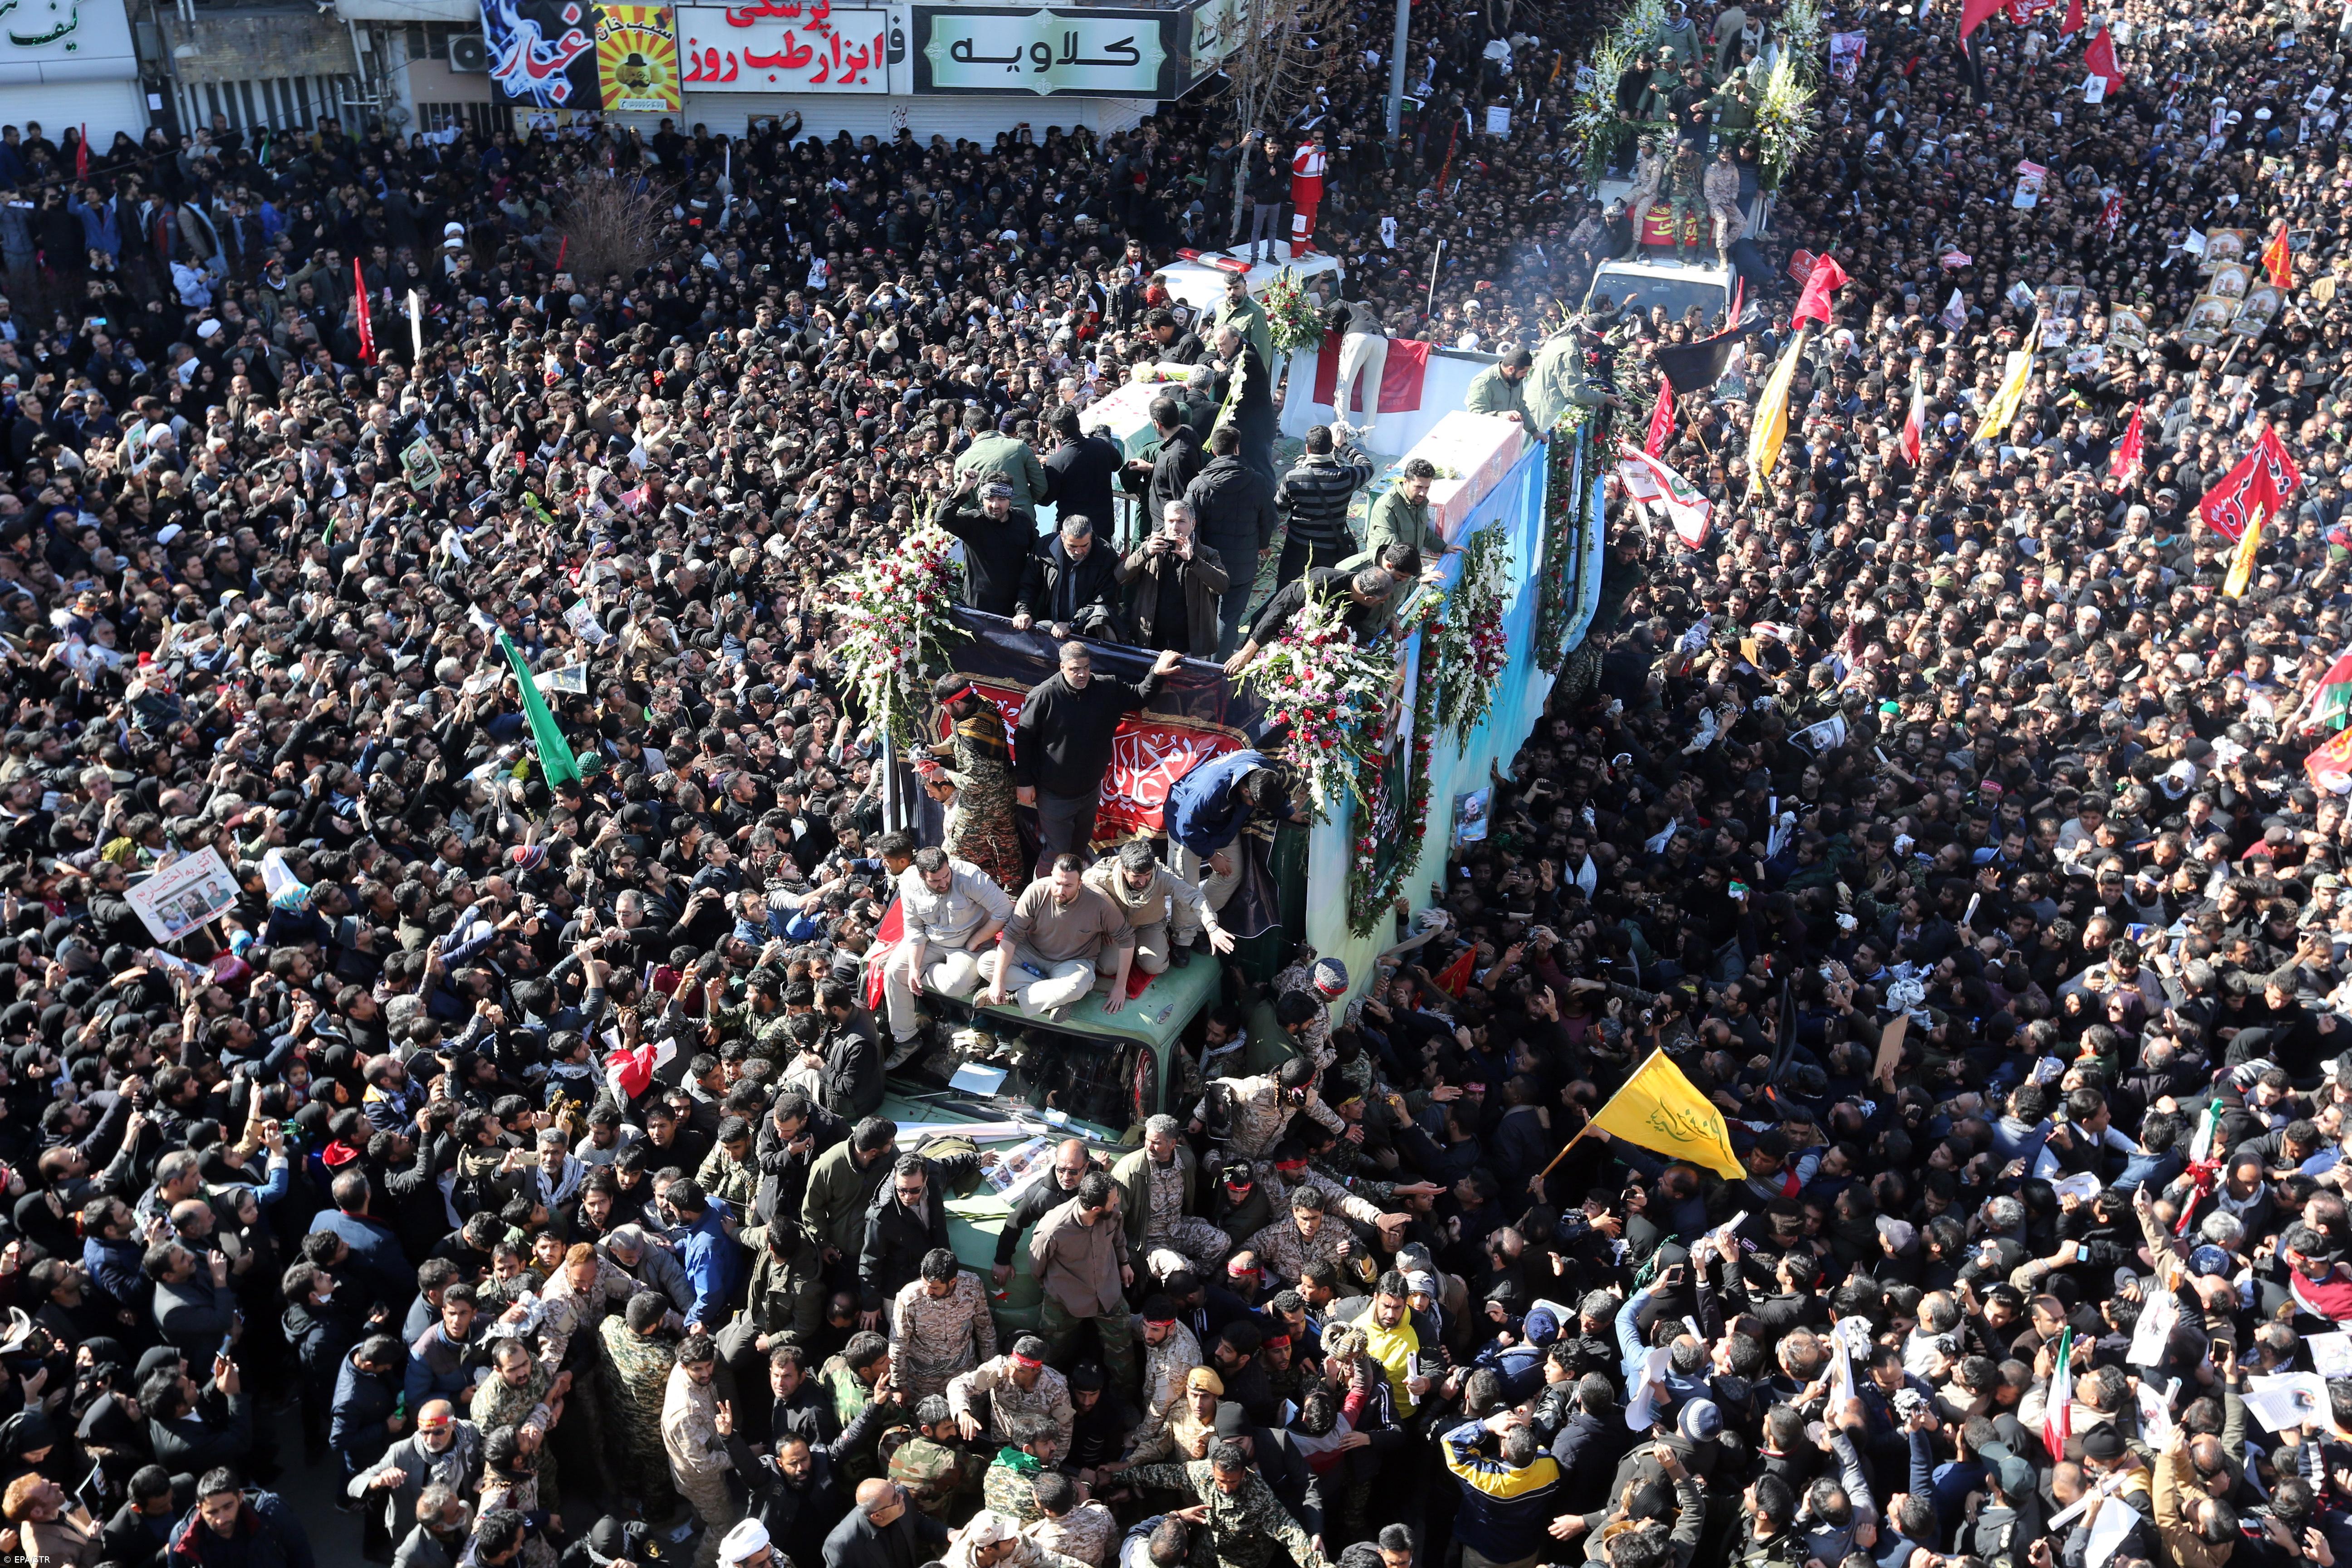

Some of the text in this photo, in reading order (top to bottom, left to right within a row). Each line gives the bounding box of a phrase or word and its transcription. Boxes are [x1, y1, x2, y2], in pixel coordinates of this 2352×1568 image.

[494, 5, 591, 100] غبار
[598, 17, 673, 41] سیب خان
[951, 31, 1140, 73] کلاویه
[682, 37, 738, 82] روز
[744, 29, 813, 83] طب
[810, 30, 884, 85] ابزار
